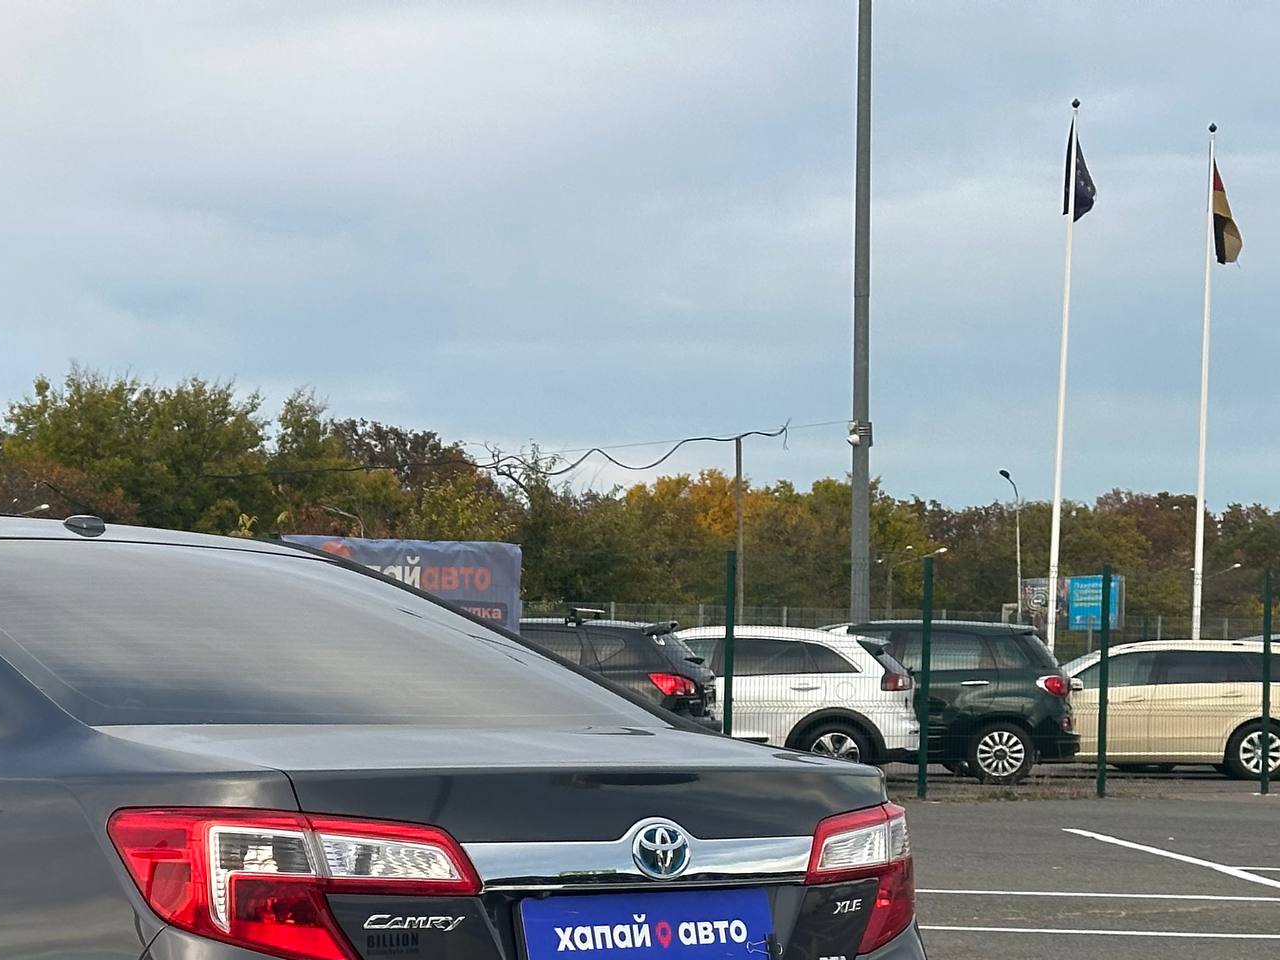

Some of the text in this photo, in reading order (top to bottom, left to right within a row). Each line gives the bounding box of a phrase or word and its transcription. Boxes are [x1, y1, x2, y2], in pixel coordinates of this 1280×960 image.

[833, 899, 862, 914] XLE
[367, 932, 419, 948] BILLION
[554, 914, 748, 952] хапай авто
